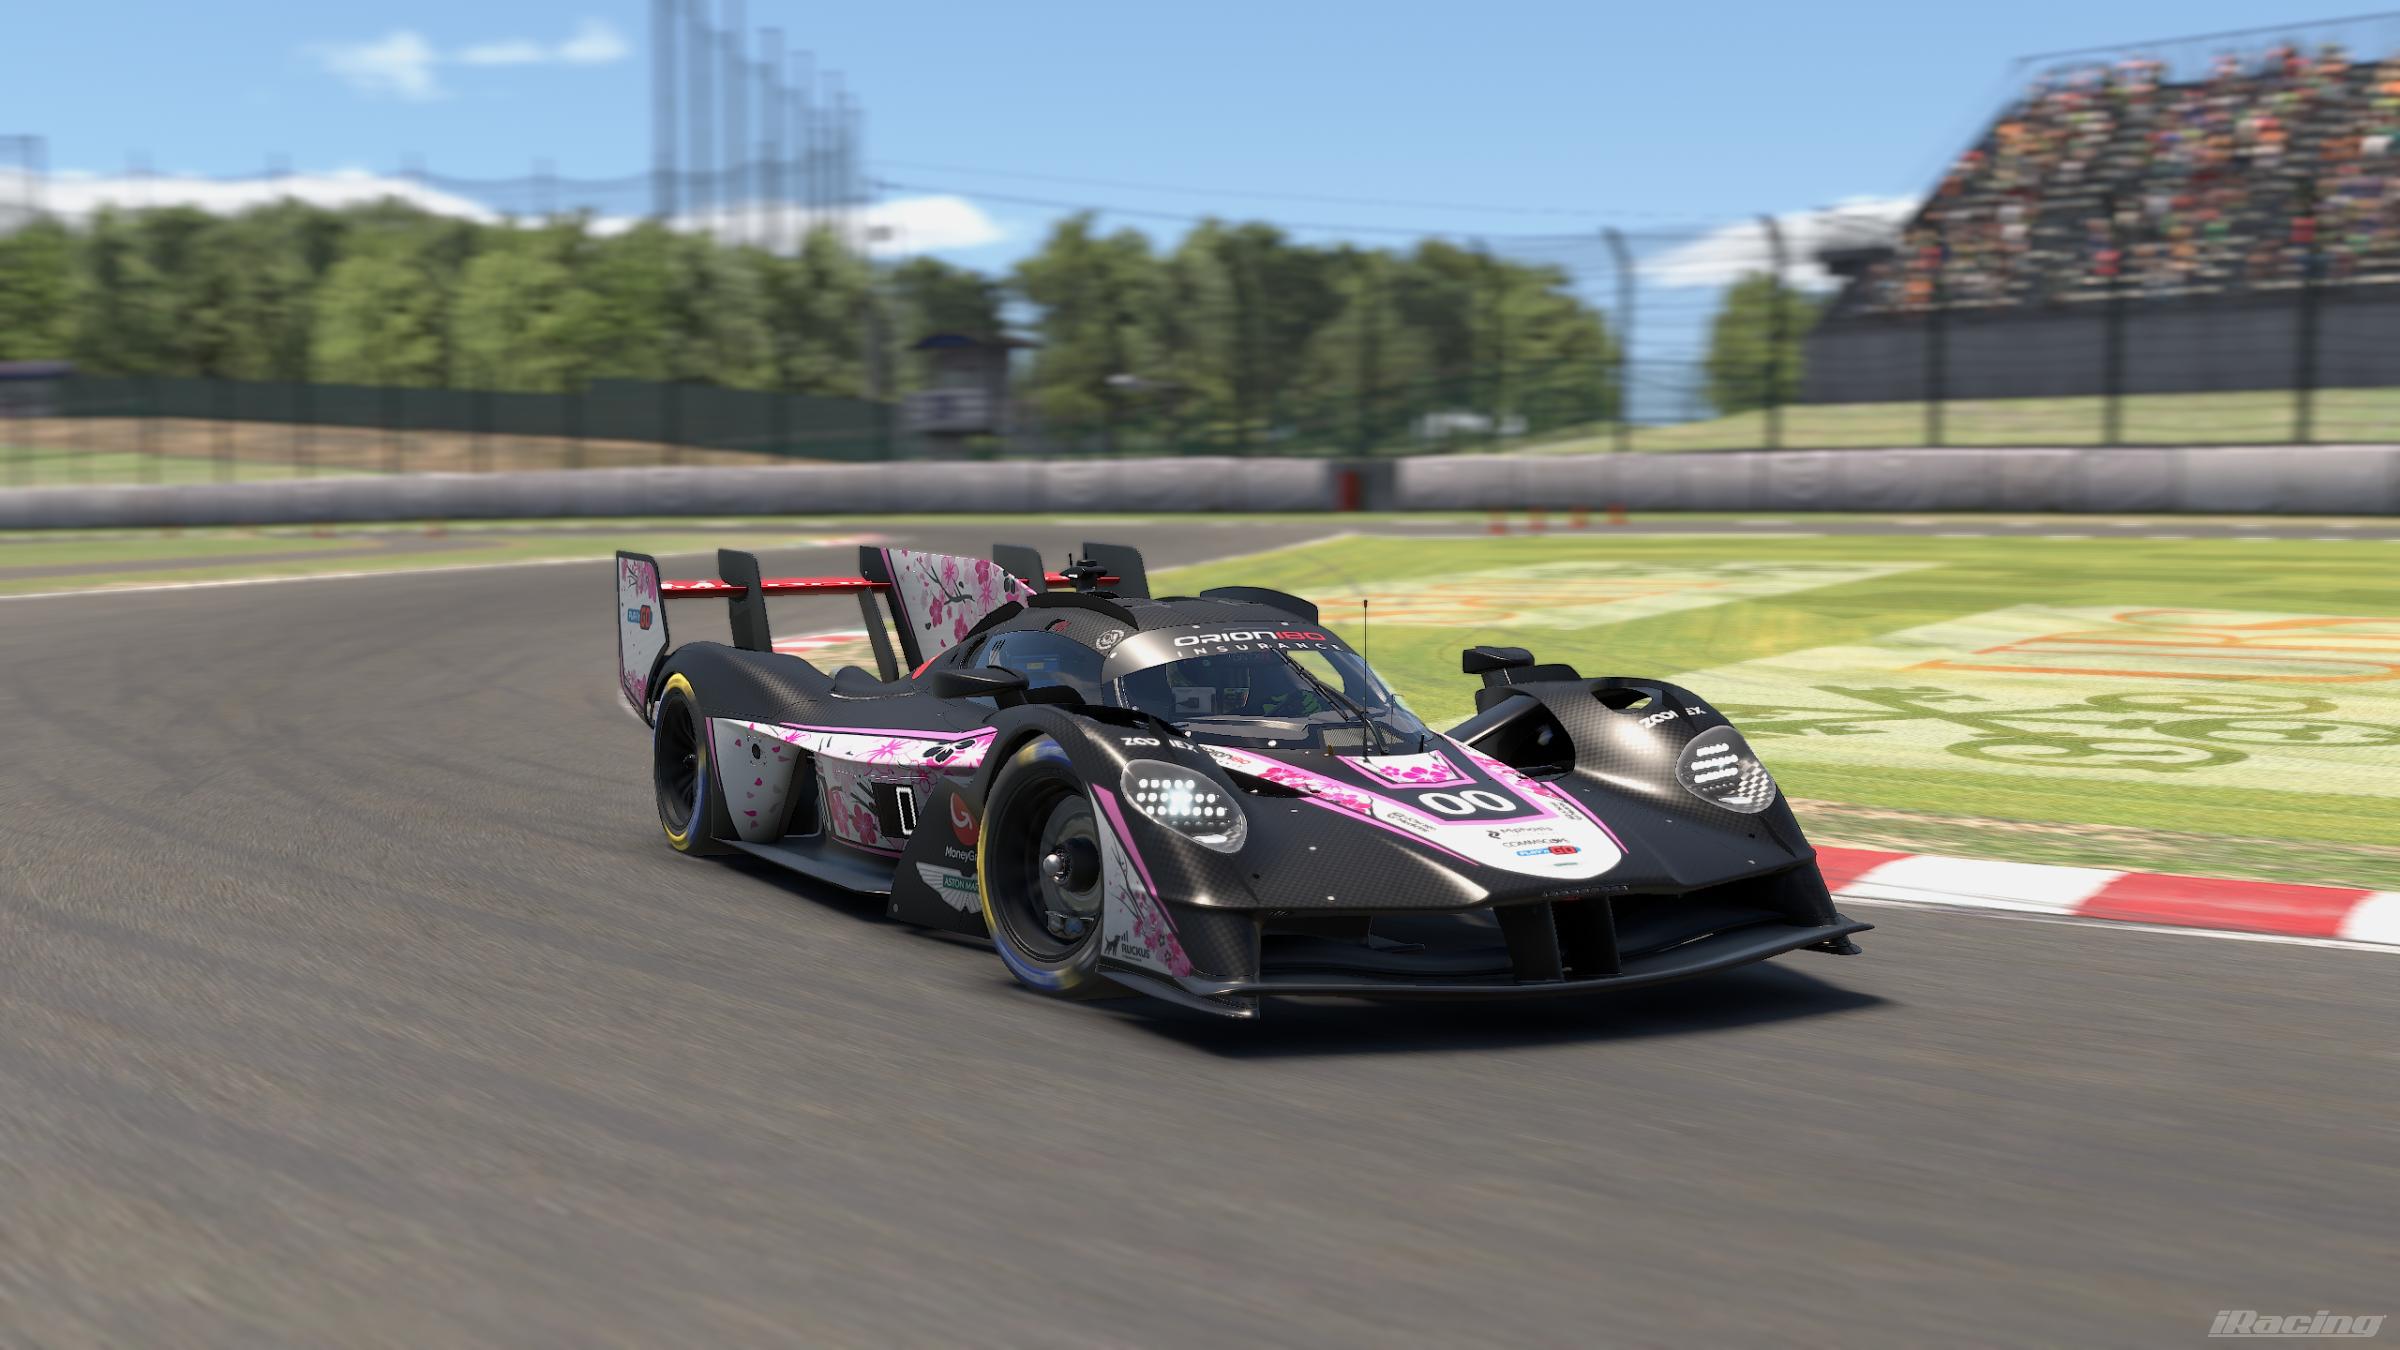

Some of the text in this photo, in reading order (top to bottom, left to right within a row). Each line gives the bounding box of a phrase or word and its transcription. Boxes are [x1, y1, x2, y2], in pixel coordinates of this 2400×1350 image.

[1177, 642, 1344, 658] INSURANCE
[1418, 790, 1517, 815] 00
[944, 880, 965, 890] ASTON
[1121, 944, 1150, 959] RUCKUS
